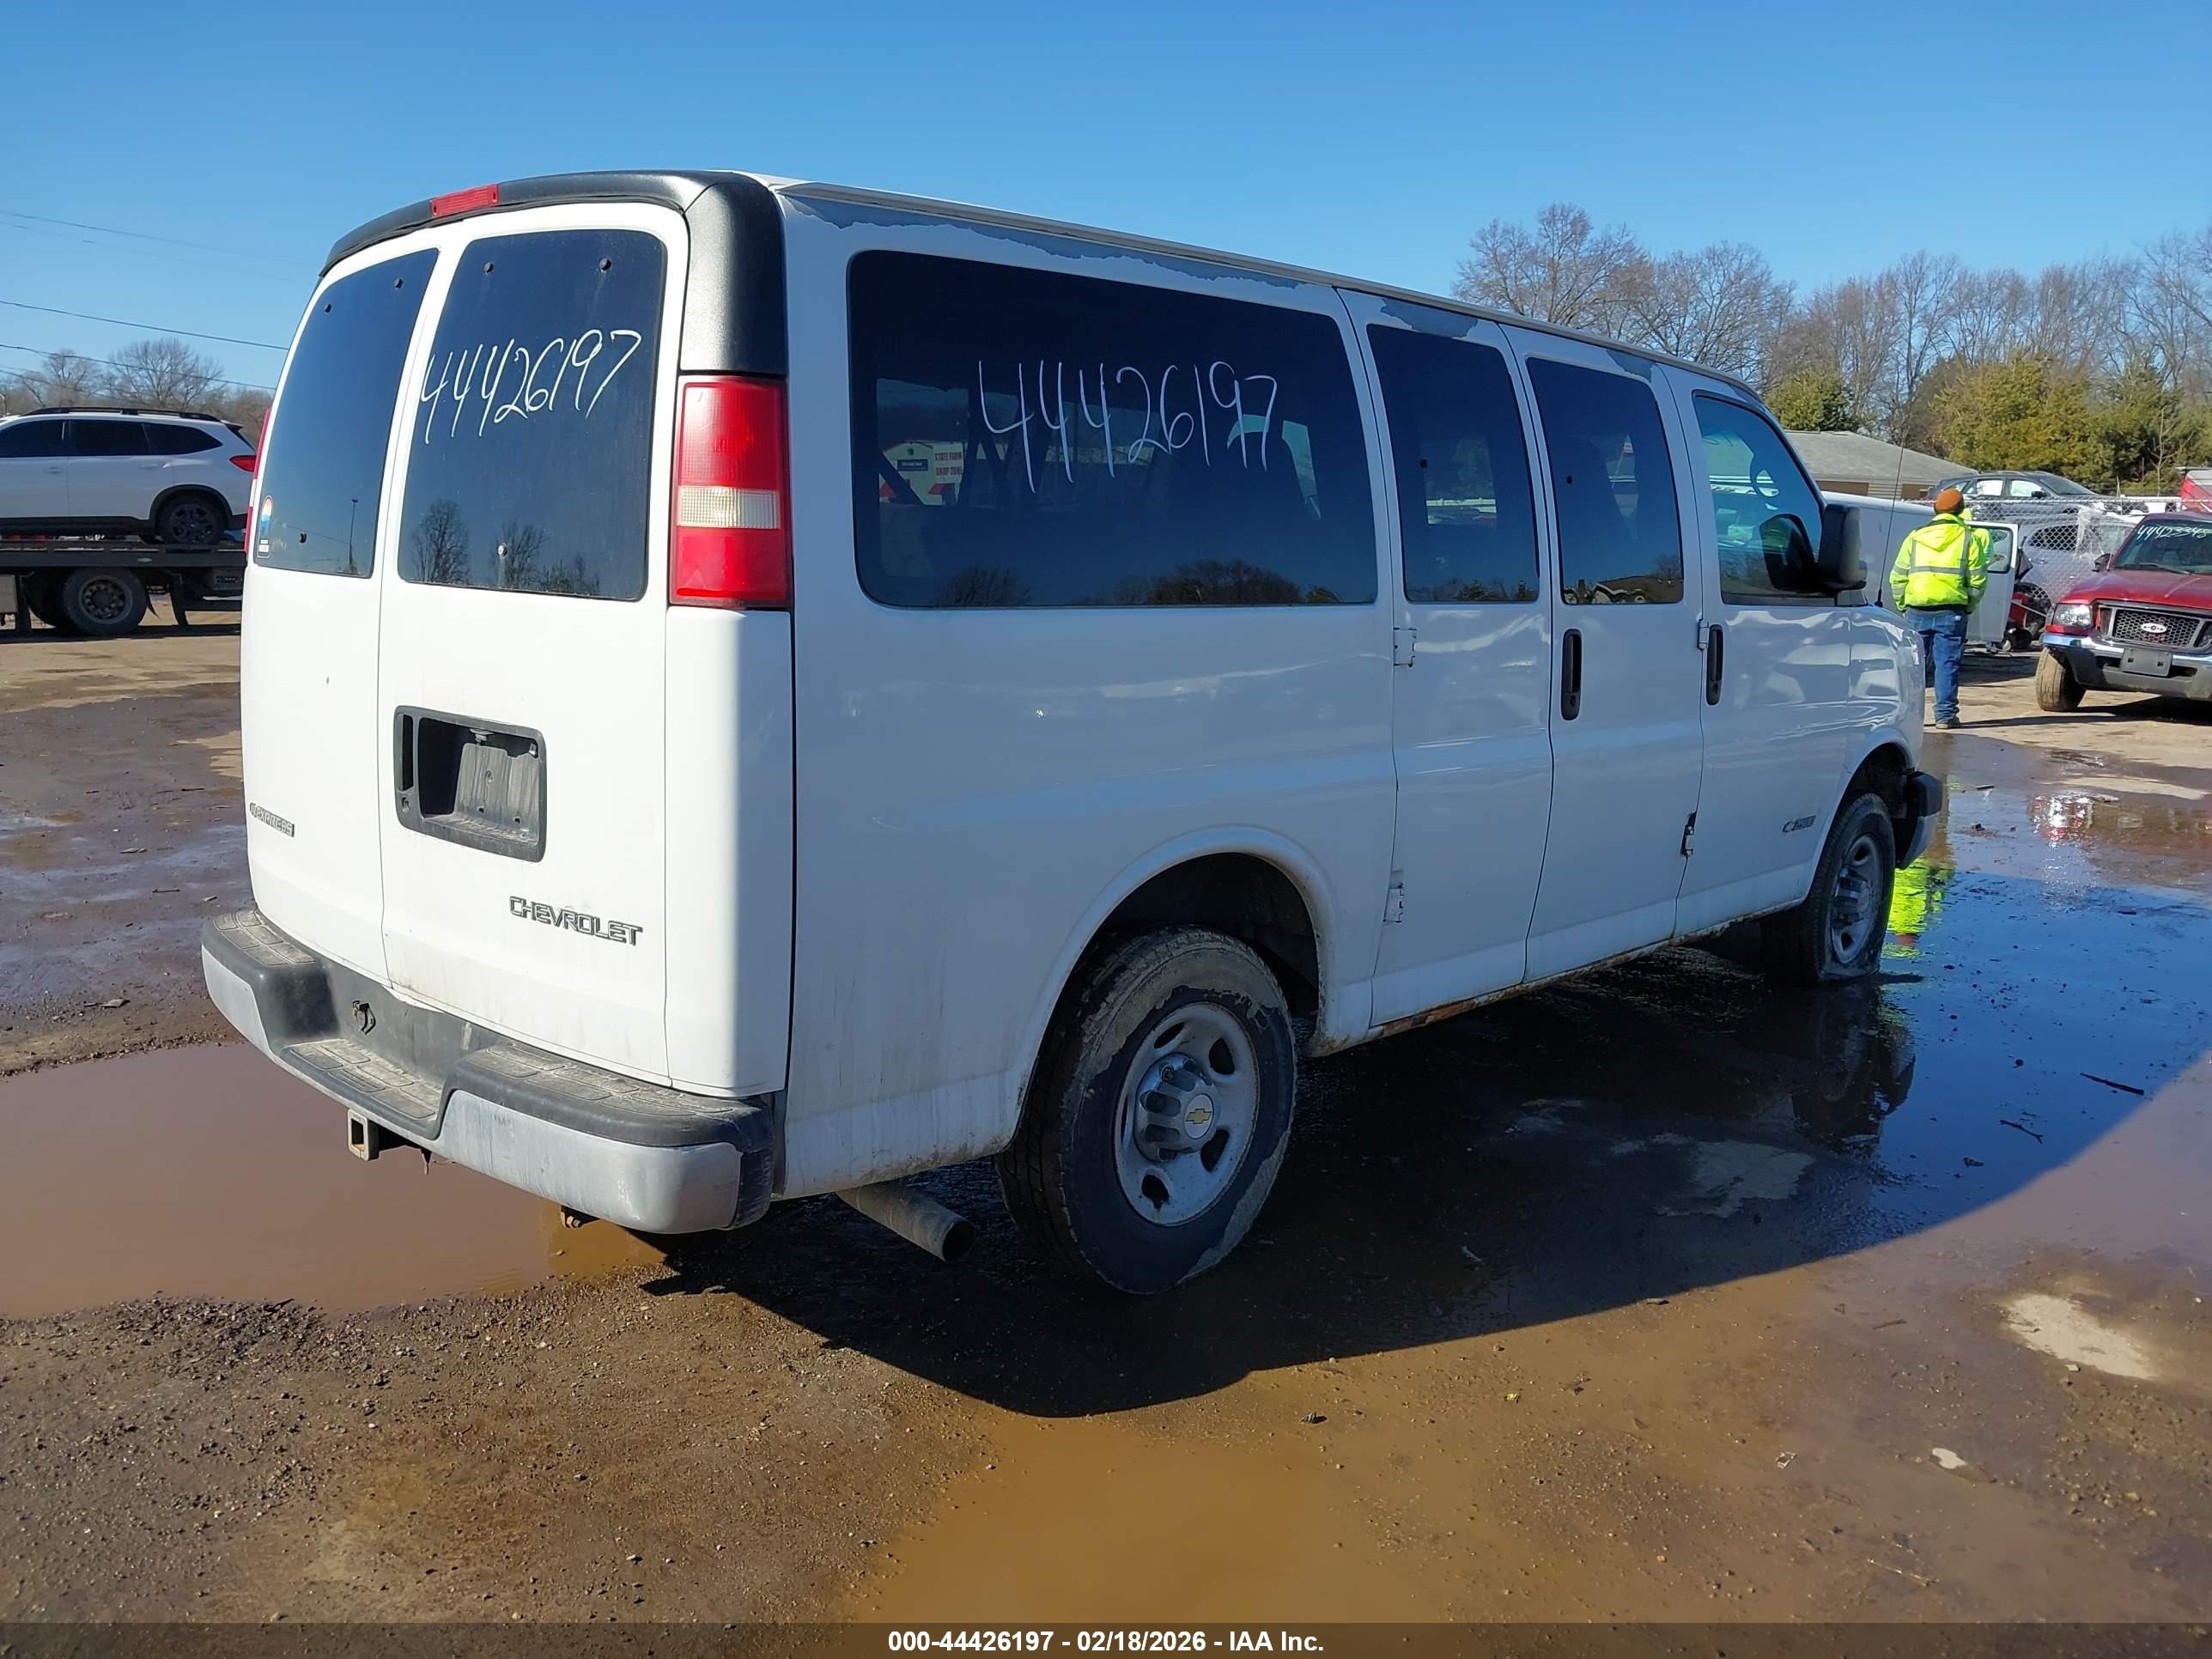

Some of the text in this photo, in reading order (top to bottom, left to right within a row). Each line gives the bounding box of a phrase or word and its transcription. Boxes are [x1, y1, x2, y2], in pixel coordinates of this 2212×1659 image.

[421, 329, 641, 445] 44426197
[978, 359, 1279, 494] 44426197
[509, 896, 643, 946] CHEVROLET
